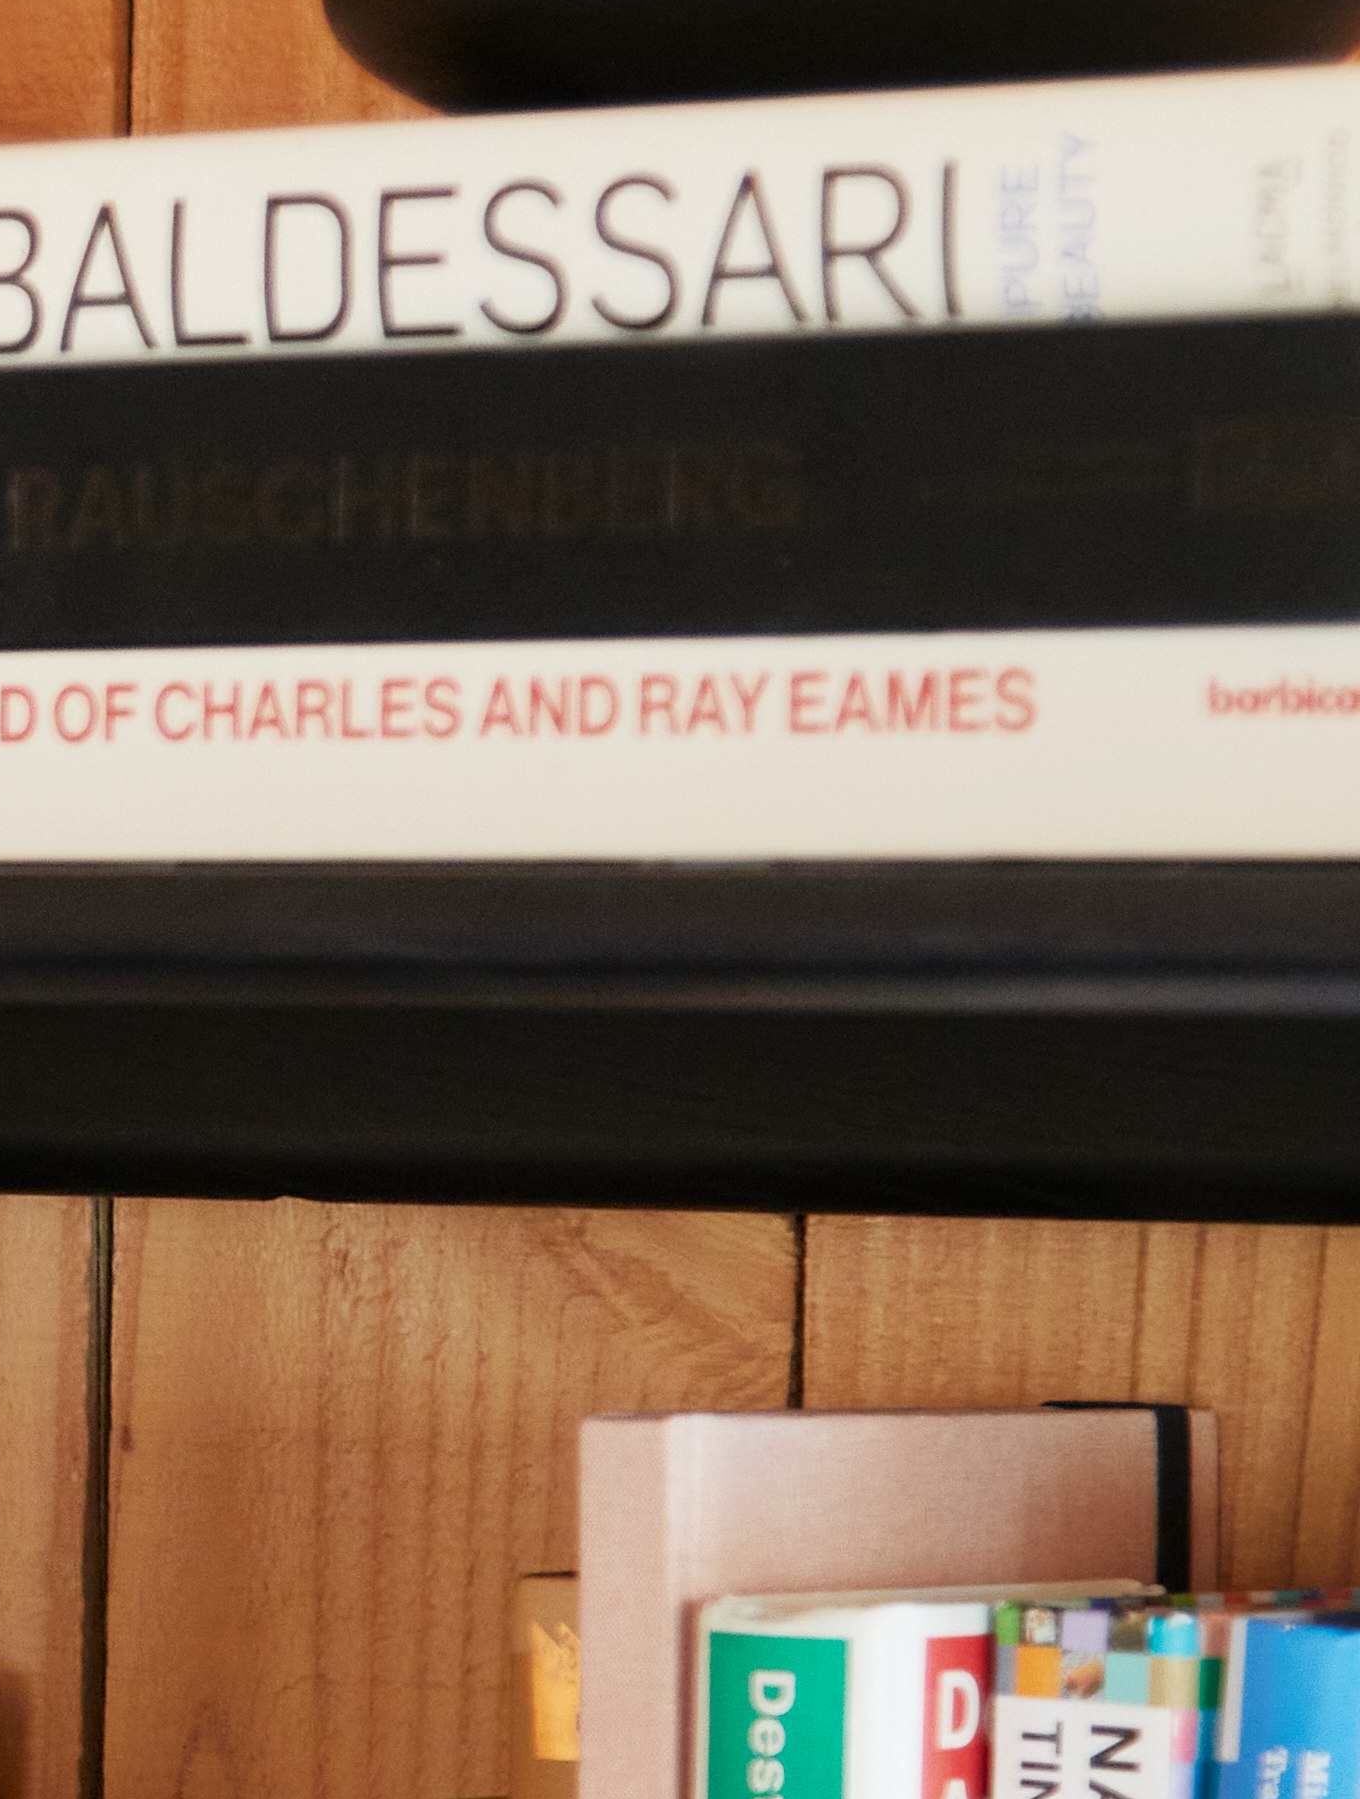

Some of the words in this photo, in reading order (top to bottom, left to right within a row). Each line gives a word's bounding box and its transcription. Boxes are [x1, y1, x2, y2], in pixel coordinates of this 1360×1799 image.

[996, 164, 1041, 312] PURE
[53, 684, 139, 744] OF
[153, 675, 463, 742] CHARLES
[478, 674, 620, 737] AND
[639, 670, 772, 735] RAY
[784, 668, 1038, 735] EAMES
